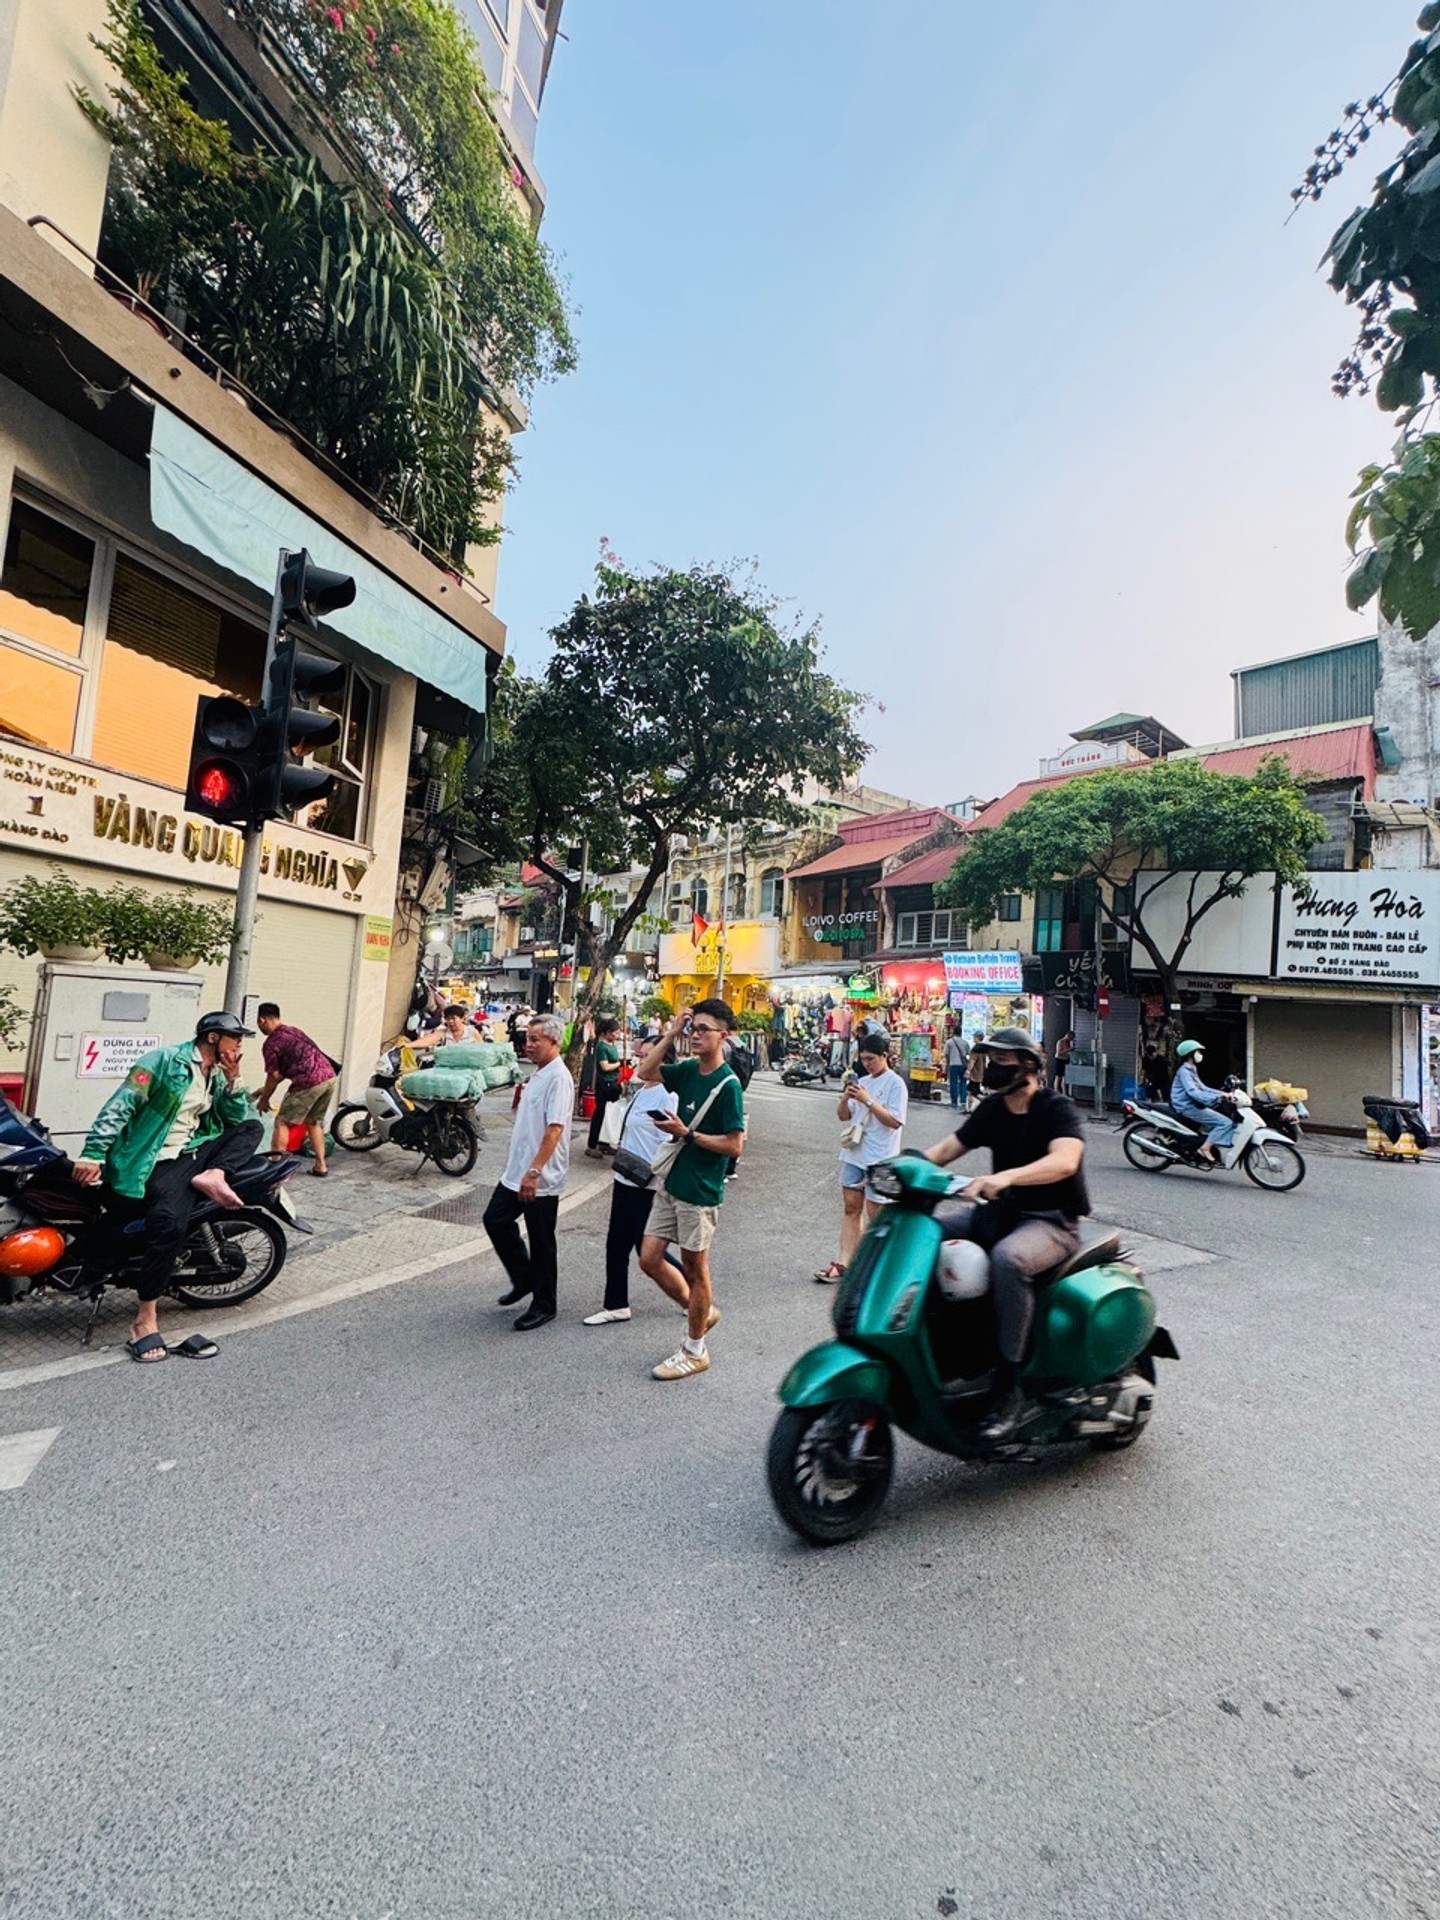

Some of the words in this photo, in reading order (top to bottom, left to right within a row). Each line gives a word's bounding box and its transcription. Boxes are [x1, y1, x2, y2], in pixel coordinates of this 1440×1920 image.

[28, 760, 46, 772] TY
[26, 796, 45, 817] 1
[93, 794, 177, 854] VÀNG
[273, 846, 338, 890] NGHĨA
[1292, 889, 1359, 927] Hưng
[1370, 888, 1425, 919] Hoà
[839, 910, 879, 924] COFFEE
[1353, 929, 1378, 939] BUÔN
[1353, 943, 1383, 952] TRANG
[1386, 944, 1405, 954] CAO
[947, 966, 986, 979] BOOKING
[988, 966, 1020, 979] OFFICE
